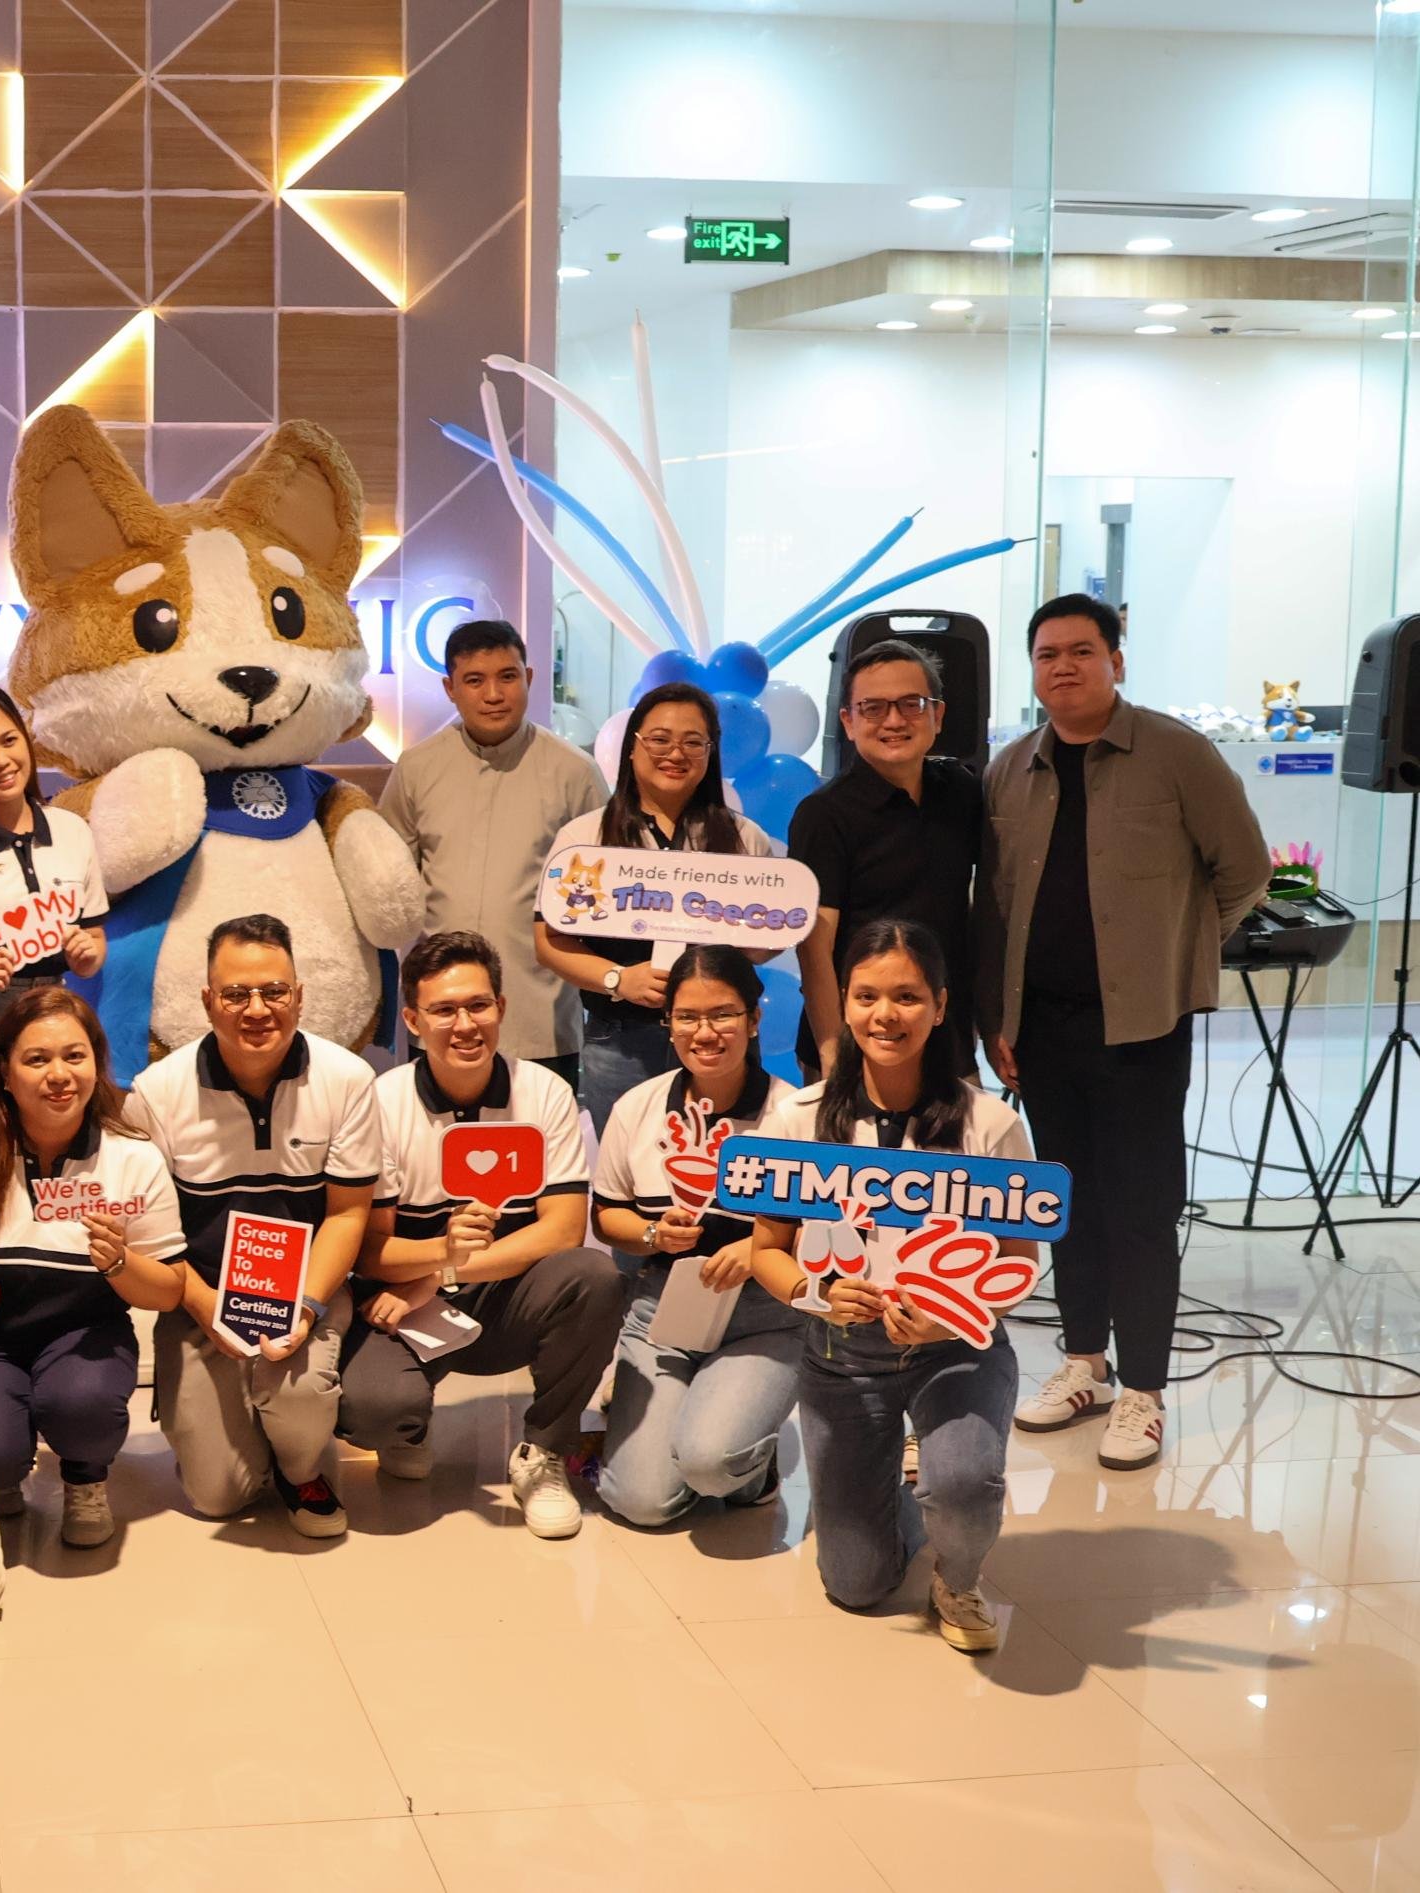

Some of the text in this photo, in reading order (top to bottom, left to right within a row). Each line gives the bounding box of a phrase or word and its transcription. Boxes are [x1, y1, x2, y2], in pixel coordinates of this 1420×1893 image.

[693, 222, 721, 234] Fire
[693, 236, 721, 249] exit
[618, 864, 785, 888] Made friends with
[33, 889, 75, 922] My
[612, 882, 808, 930] Tim CeeCee
[506, 1151, 519, 1174] 1
[35, 1180, 102, 1200] We're
[724, 1154, 1062, 1228] #TMCClinic
[37, 1195, 147, 1222] Certified!
[237, 1223, 288, 1245] Great
[235, 1238, 285, 1260] Place
[233, 1255, 253, 1271] To
[230, 1297, 288, 1318] Certified
